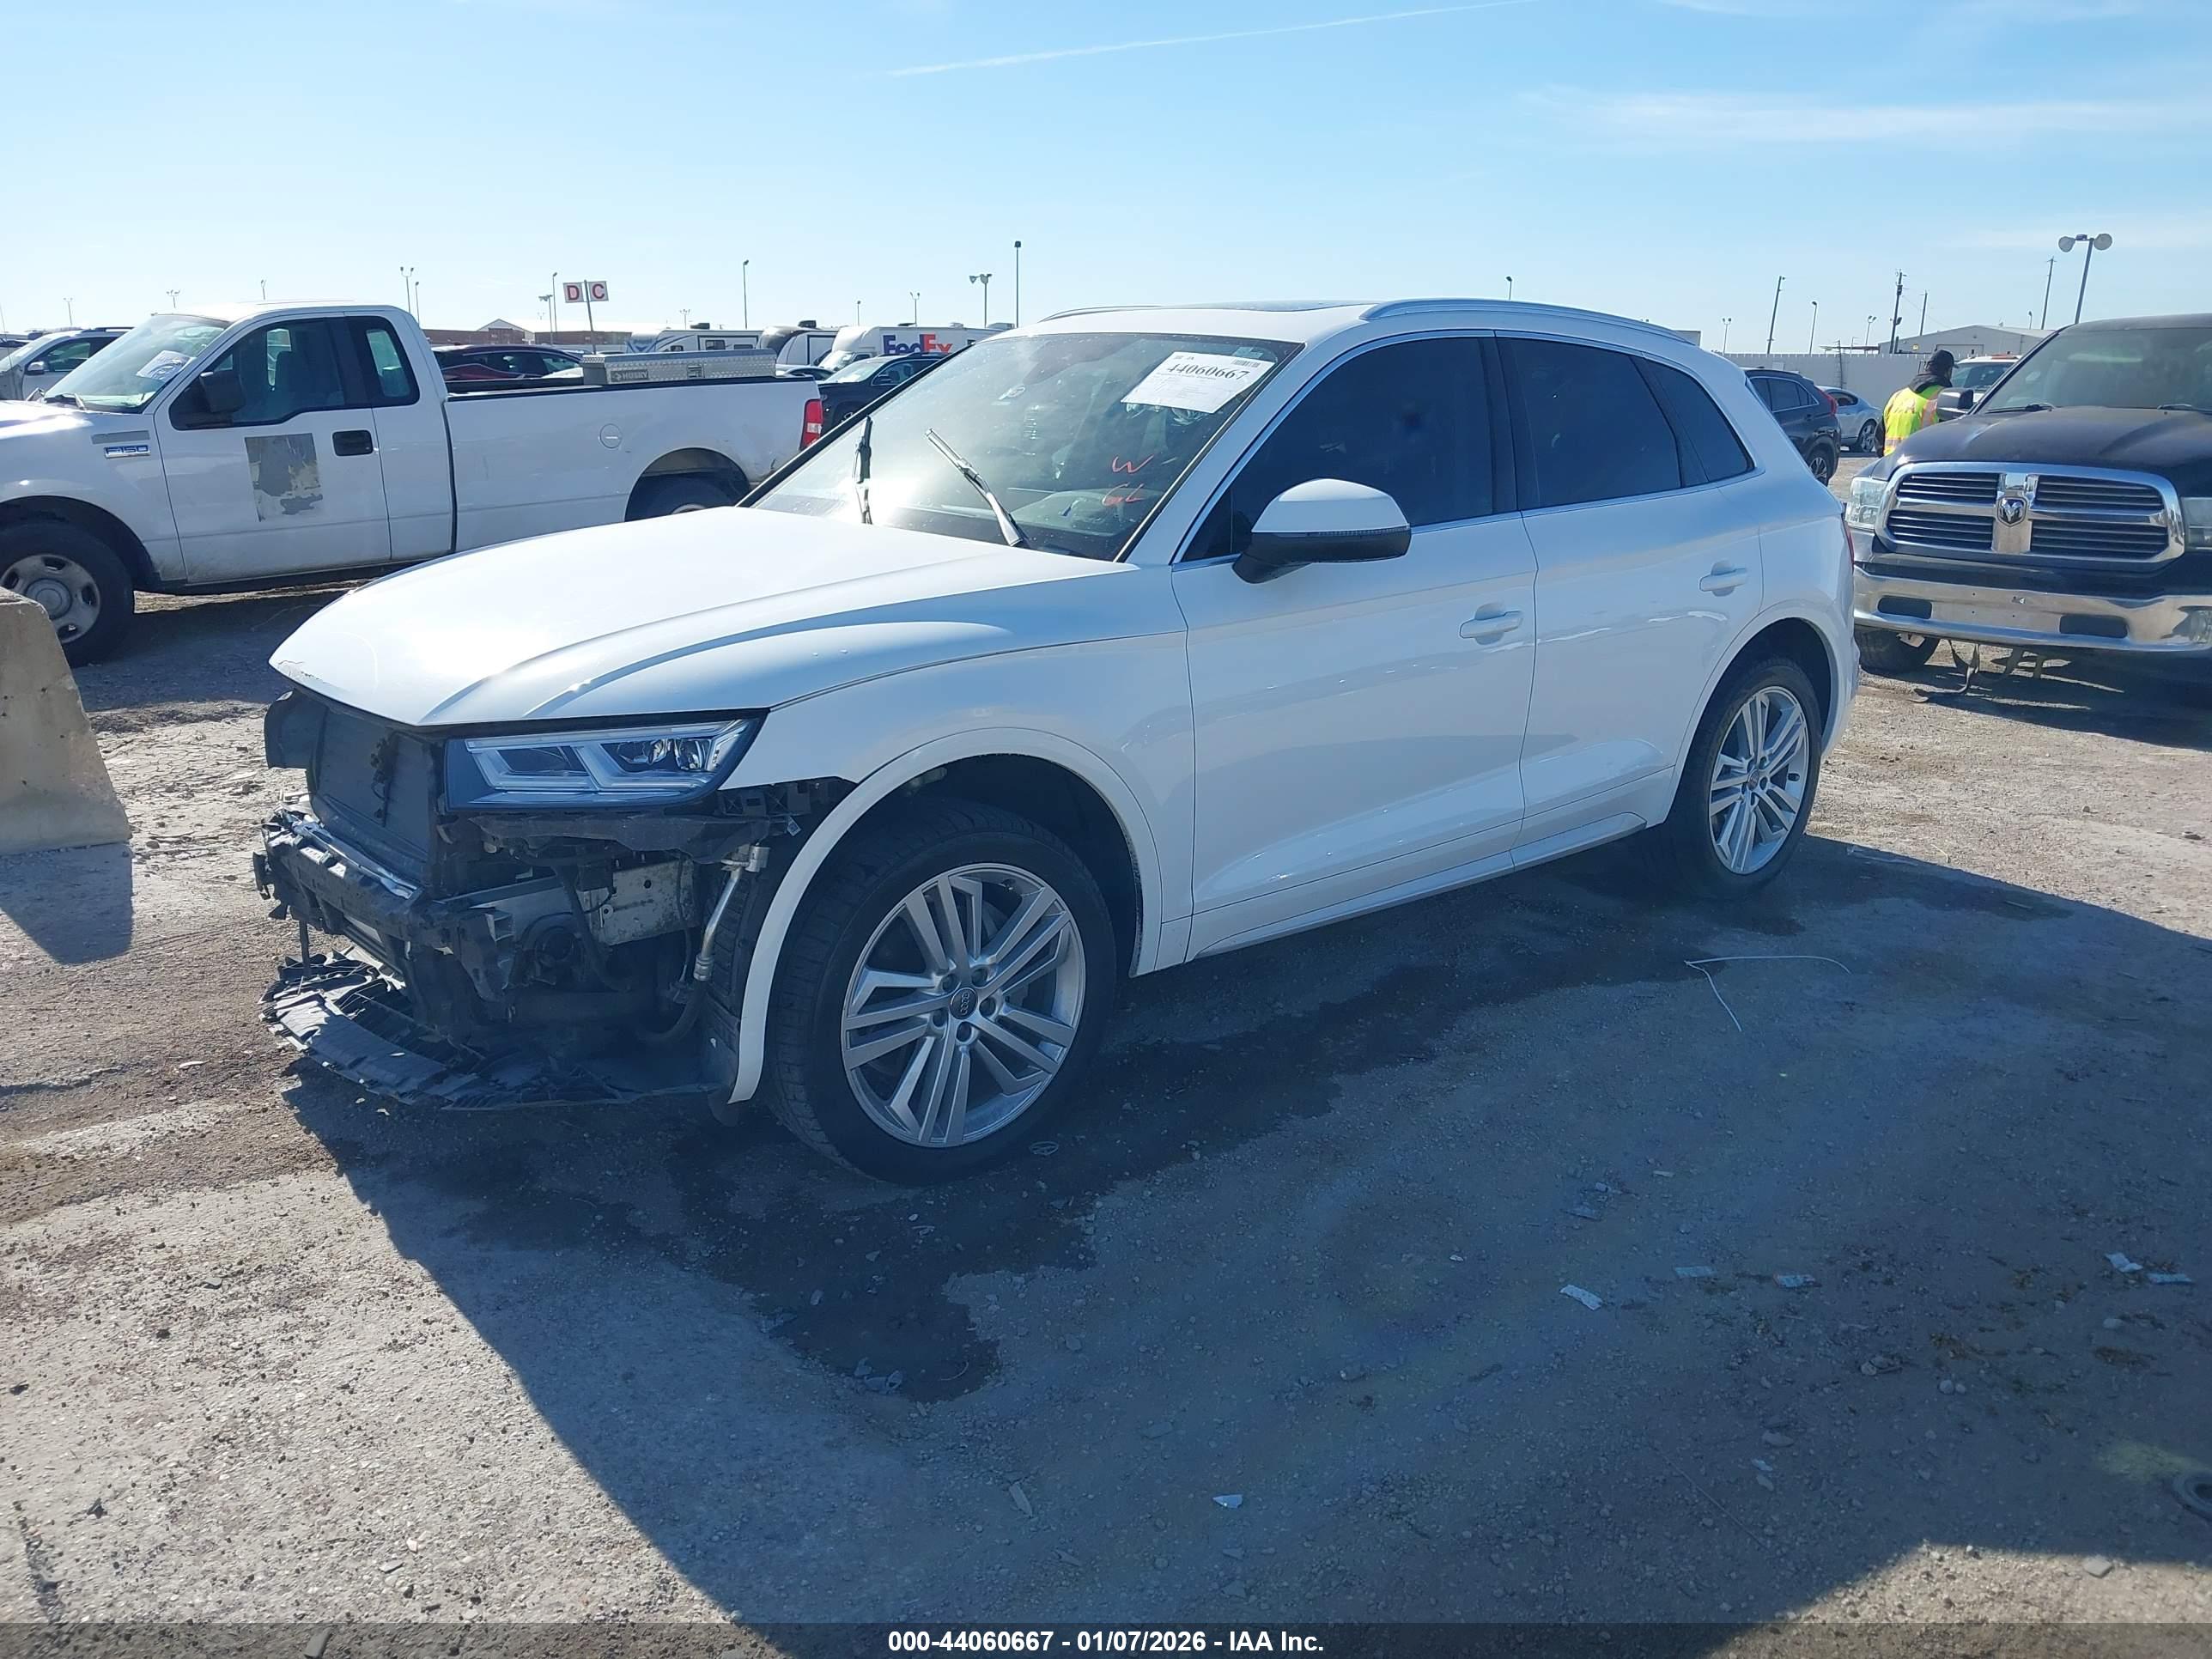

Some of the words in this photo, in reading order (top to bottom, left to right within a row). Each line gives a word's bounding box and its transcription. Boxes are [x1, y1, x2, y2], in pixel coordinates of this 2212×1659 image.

[567, 285, 580, 301] D
[592, 283, 605, 299] C
[883, 333, 953, 355] FedEx
[1167, 363, 1250, 380] 44060667
